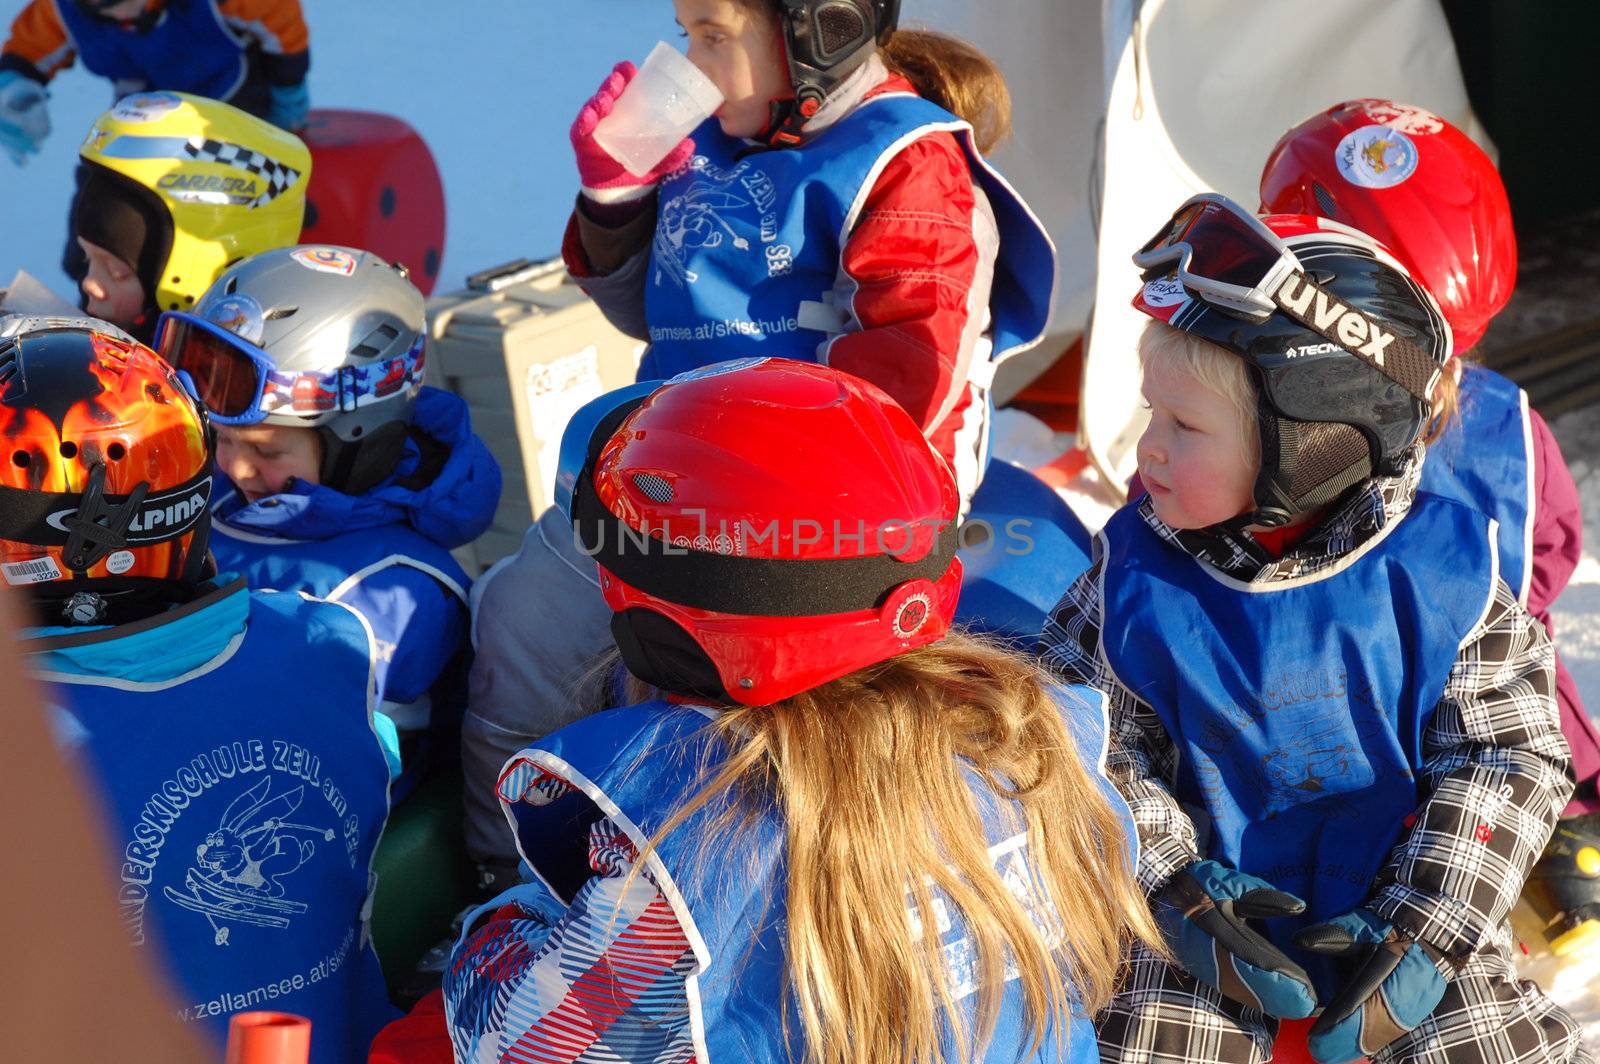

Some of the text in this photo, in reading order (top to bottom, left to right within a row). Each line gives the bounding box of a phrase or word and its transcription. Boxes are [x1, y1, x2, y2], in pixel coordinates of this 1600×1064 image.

[157, 173, 257, 195] CARRERA
[1278, 273, 1395, 367] uvex
[36, 570, 60, 581] 3228
[273, 740, 321, 787] ZELL
[322, 777, 348, 818] am
